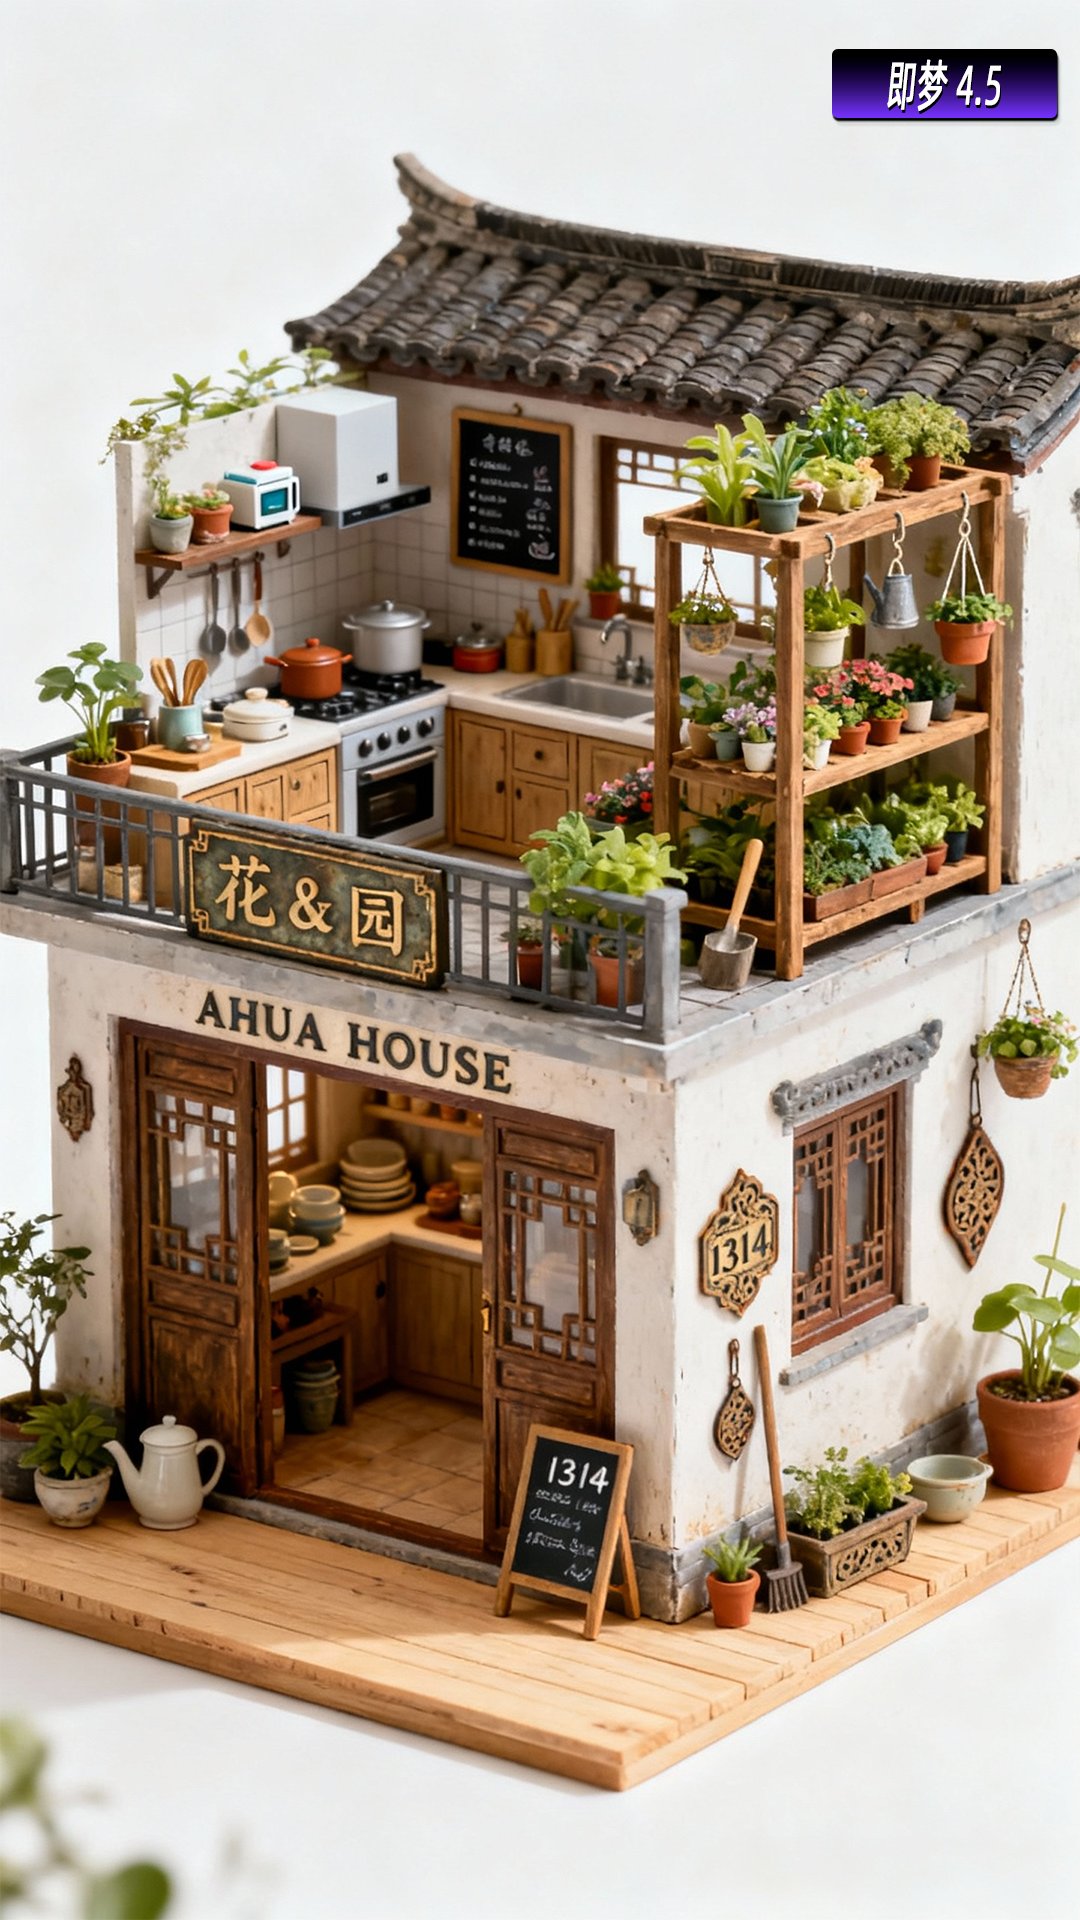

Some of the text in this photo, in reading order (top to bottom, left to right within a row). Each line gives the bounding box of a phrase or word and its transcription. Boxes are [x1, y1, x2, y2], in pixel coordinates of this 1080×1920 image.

[215, 854, 404, 956] 花 & 园
[195, 990, 512, 1094] AHUA HOUSE
[712, 1223, 769, 1276] 1314
[548, 1456, 609, 1494] 1314
